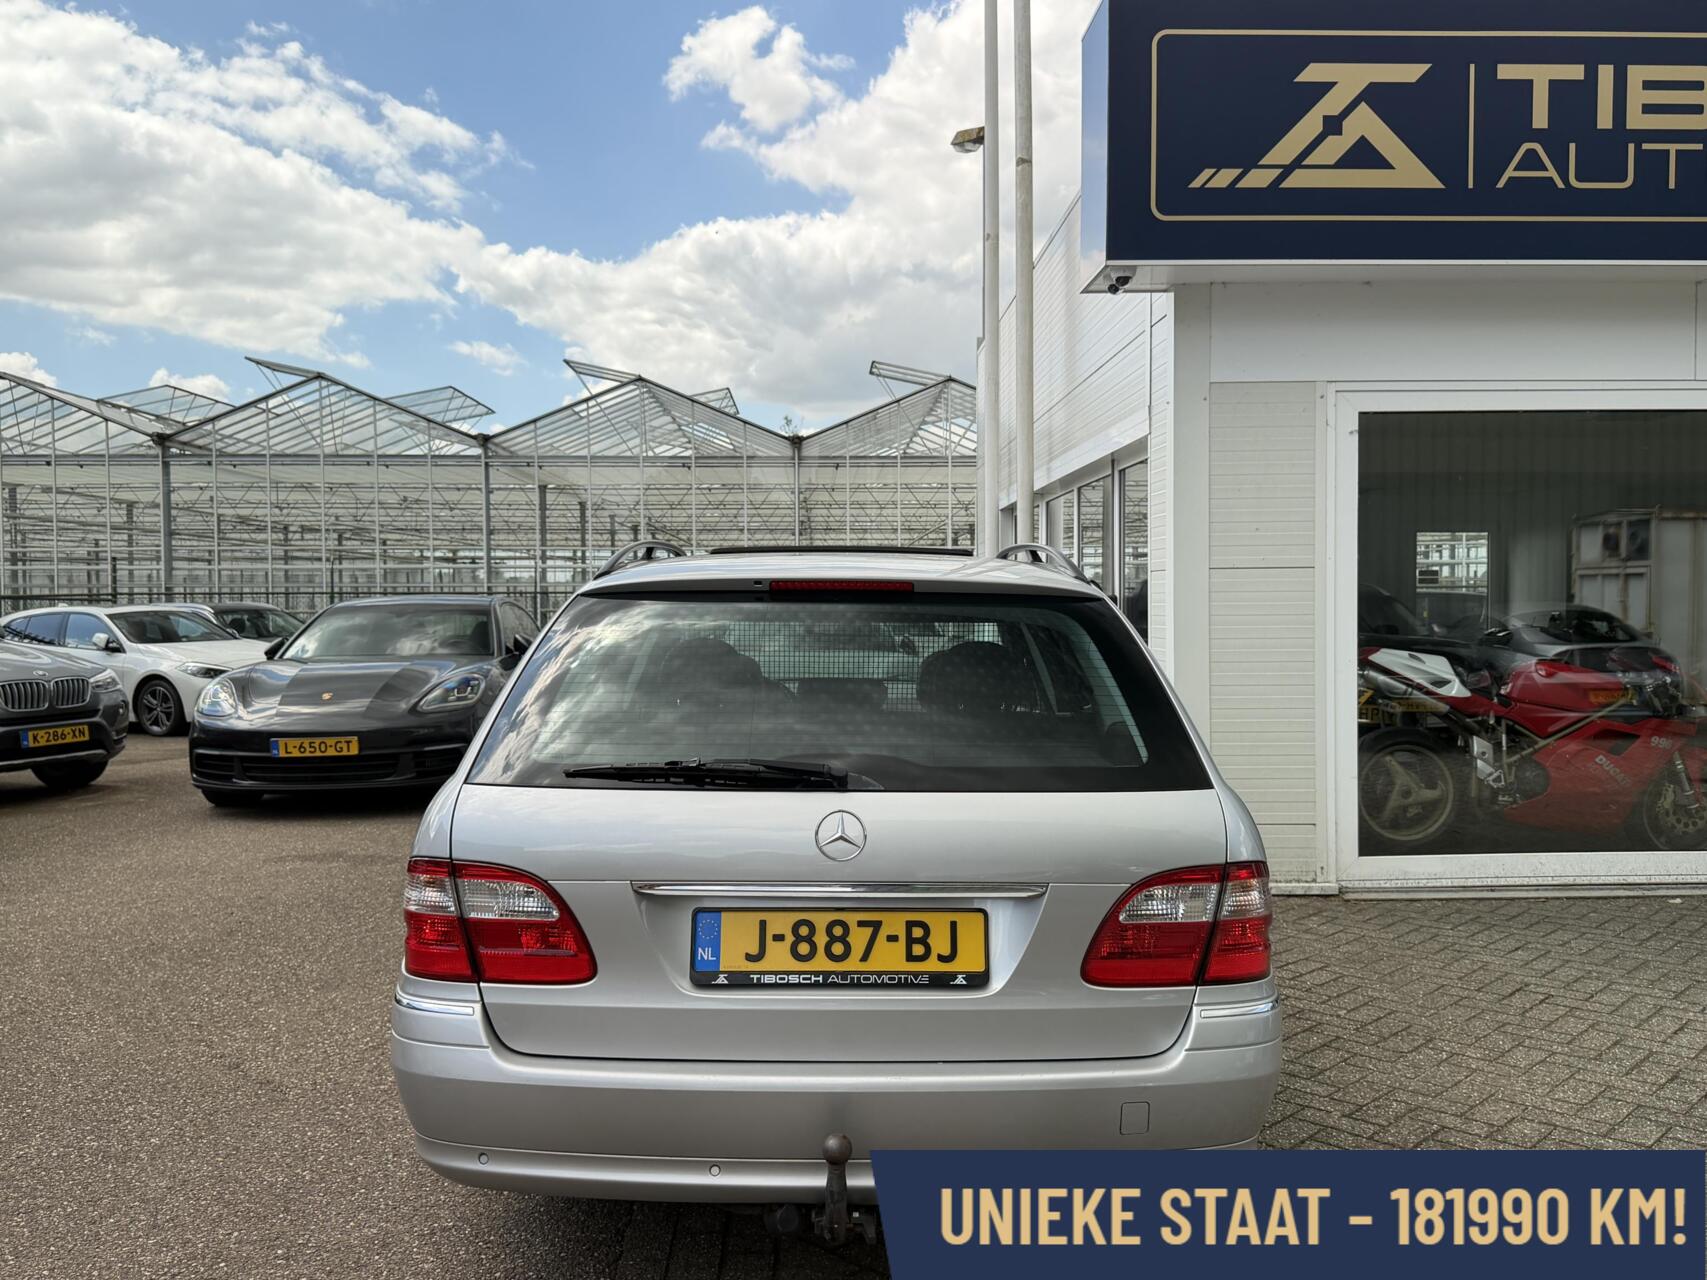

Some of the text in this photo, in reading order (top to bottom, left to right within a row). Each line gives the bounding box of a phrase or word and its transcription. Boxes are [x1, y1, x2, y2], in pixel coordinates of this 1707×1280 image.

[1496, 63, 1707, 130] TIB
[1495, 142, 1704, 189] AUT
[32, 727, 87, 745] K-286-XN
[284, 740, 353, 755] L-650-GT
[744, 918, 958, 964] J-887-BJ
[698, 947, 716, 961] NL
[749, 974, 930, 984] TIBOSCH AUTOMOTIVE
